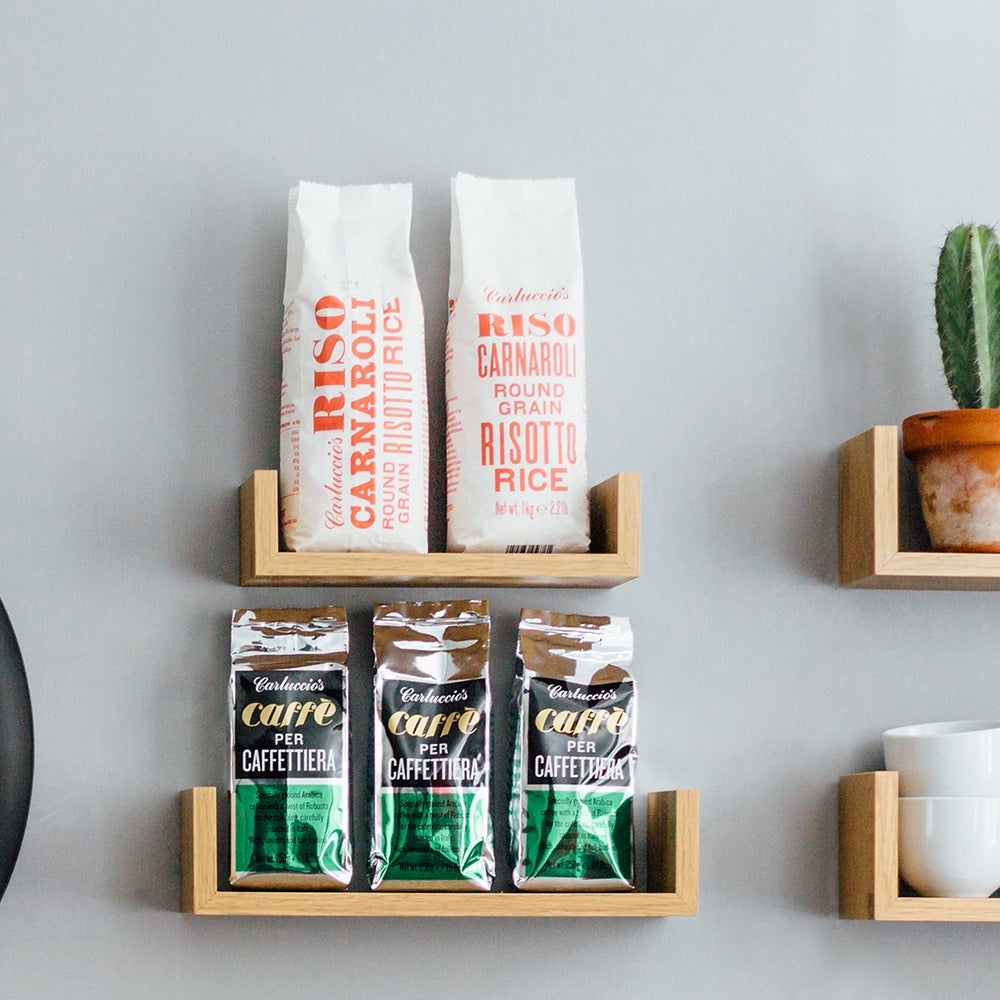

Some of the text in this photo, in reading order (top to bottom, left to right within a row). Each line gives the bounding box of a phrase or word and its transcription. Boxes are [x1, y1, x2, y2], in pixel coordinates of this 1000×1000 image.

[484, 287, 569, 304] Carluccio's
[477, 312, 576, 337] RISO
[477, 342, 576, 378] CARNAROLI
[382, 298, 413, 454] RISOTTO RICE
[494, 383, 565, 398] ROUND
[313, 295, 346, 529] Carluccio's RISO
[350, 297, 376, 529] CARNAROLI
[499, 401, 562, 415] GRAIN
[481, 421, 577, 466] RISOTTO
[495, 468, 568, 492] RICE
[382, 461, 395, 529] ROUND
[398, 463, 410, 524] GRAIN
[495, 501, 506, 515] Net
[253, 676, 324, 693] Carluccio's
[400, 687, 468, 704] Carluccio's
[547, 684, 617, 701] Carluccio's
[242, 698, 336, 728] caffè
[388, 707, 480, 738] caffè
[535, 706, 628, 735] caffè
[275, 733, 304, 745] PER
[420, 743, 448, 755] PER
[567, 740, 596, 753] PER
[242, 749, 336, 772] CAFFETTIERA
[389, 757, 480, 780] CAFFETTIERA
[535, 755, 624, 780] CAFFETTIERA
